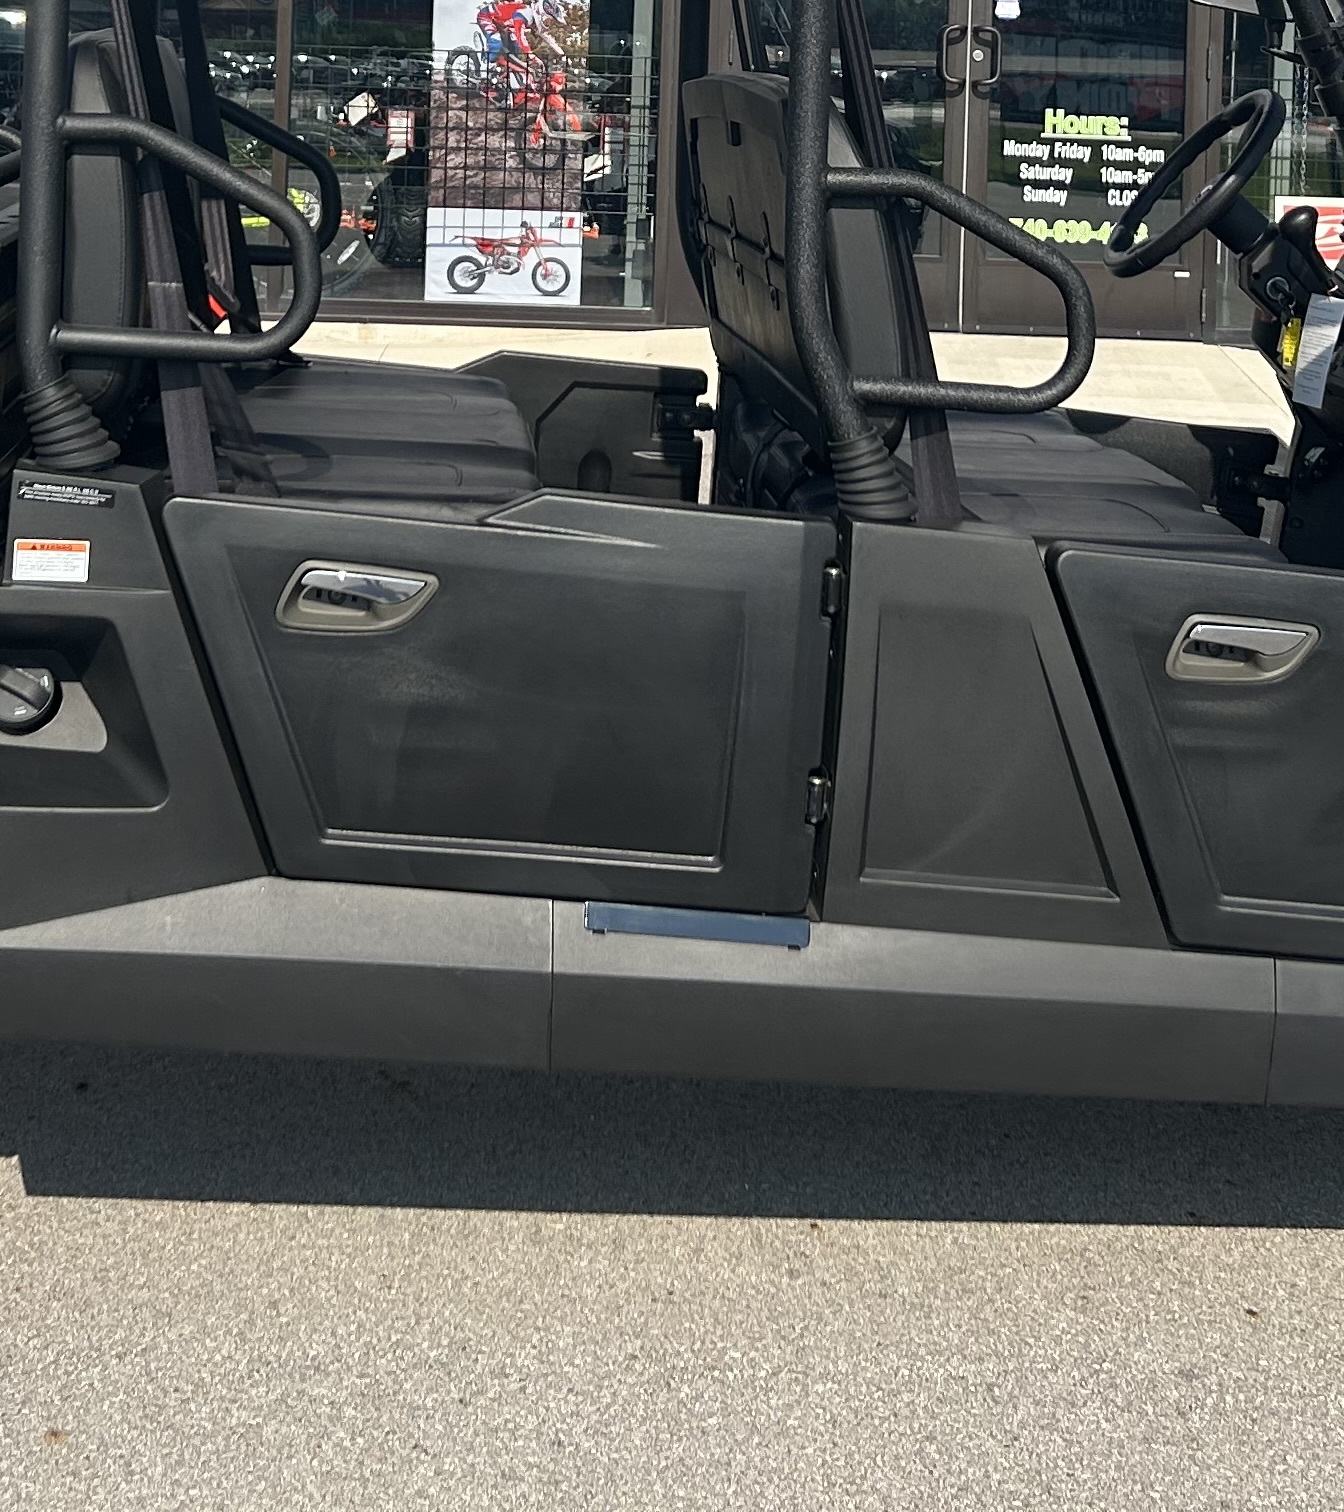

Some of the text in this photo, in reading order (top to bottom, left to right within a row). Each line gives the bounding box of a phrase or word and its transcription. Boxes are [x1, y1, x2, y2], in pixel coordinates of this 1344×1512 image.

[1044, 108, 1129, 137] Hours:
[1003, 139, 1165, 166] Monday Friday 10am-6pm
[1019, 162, 1074, 185] Saturday
[1023, 185, 1068, 207] Sunday
